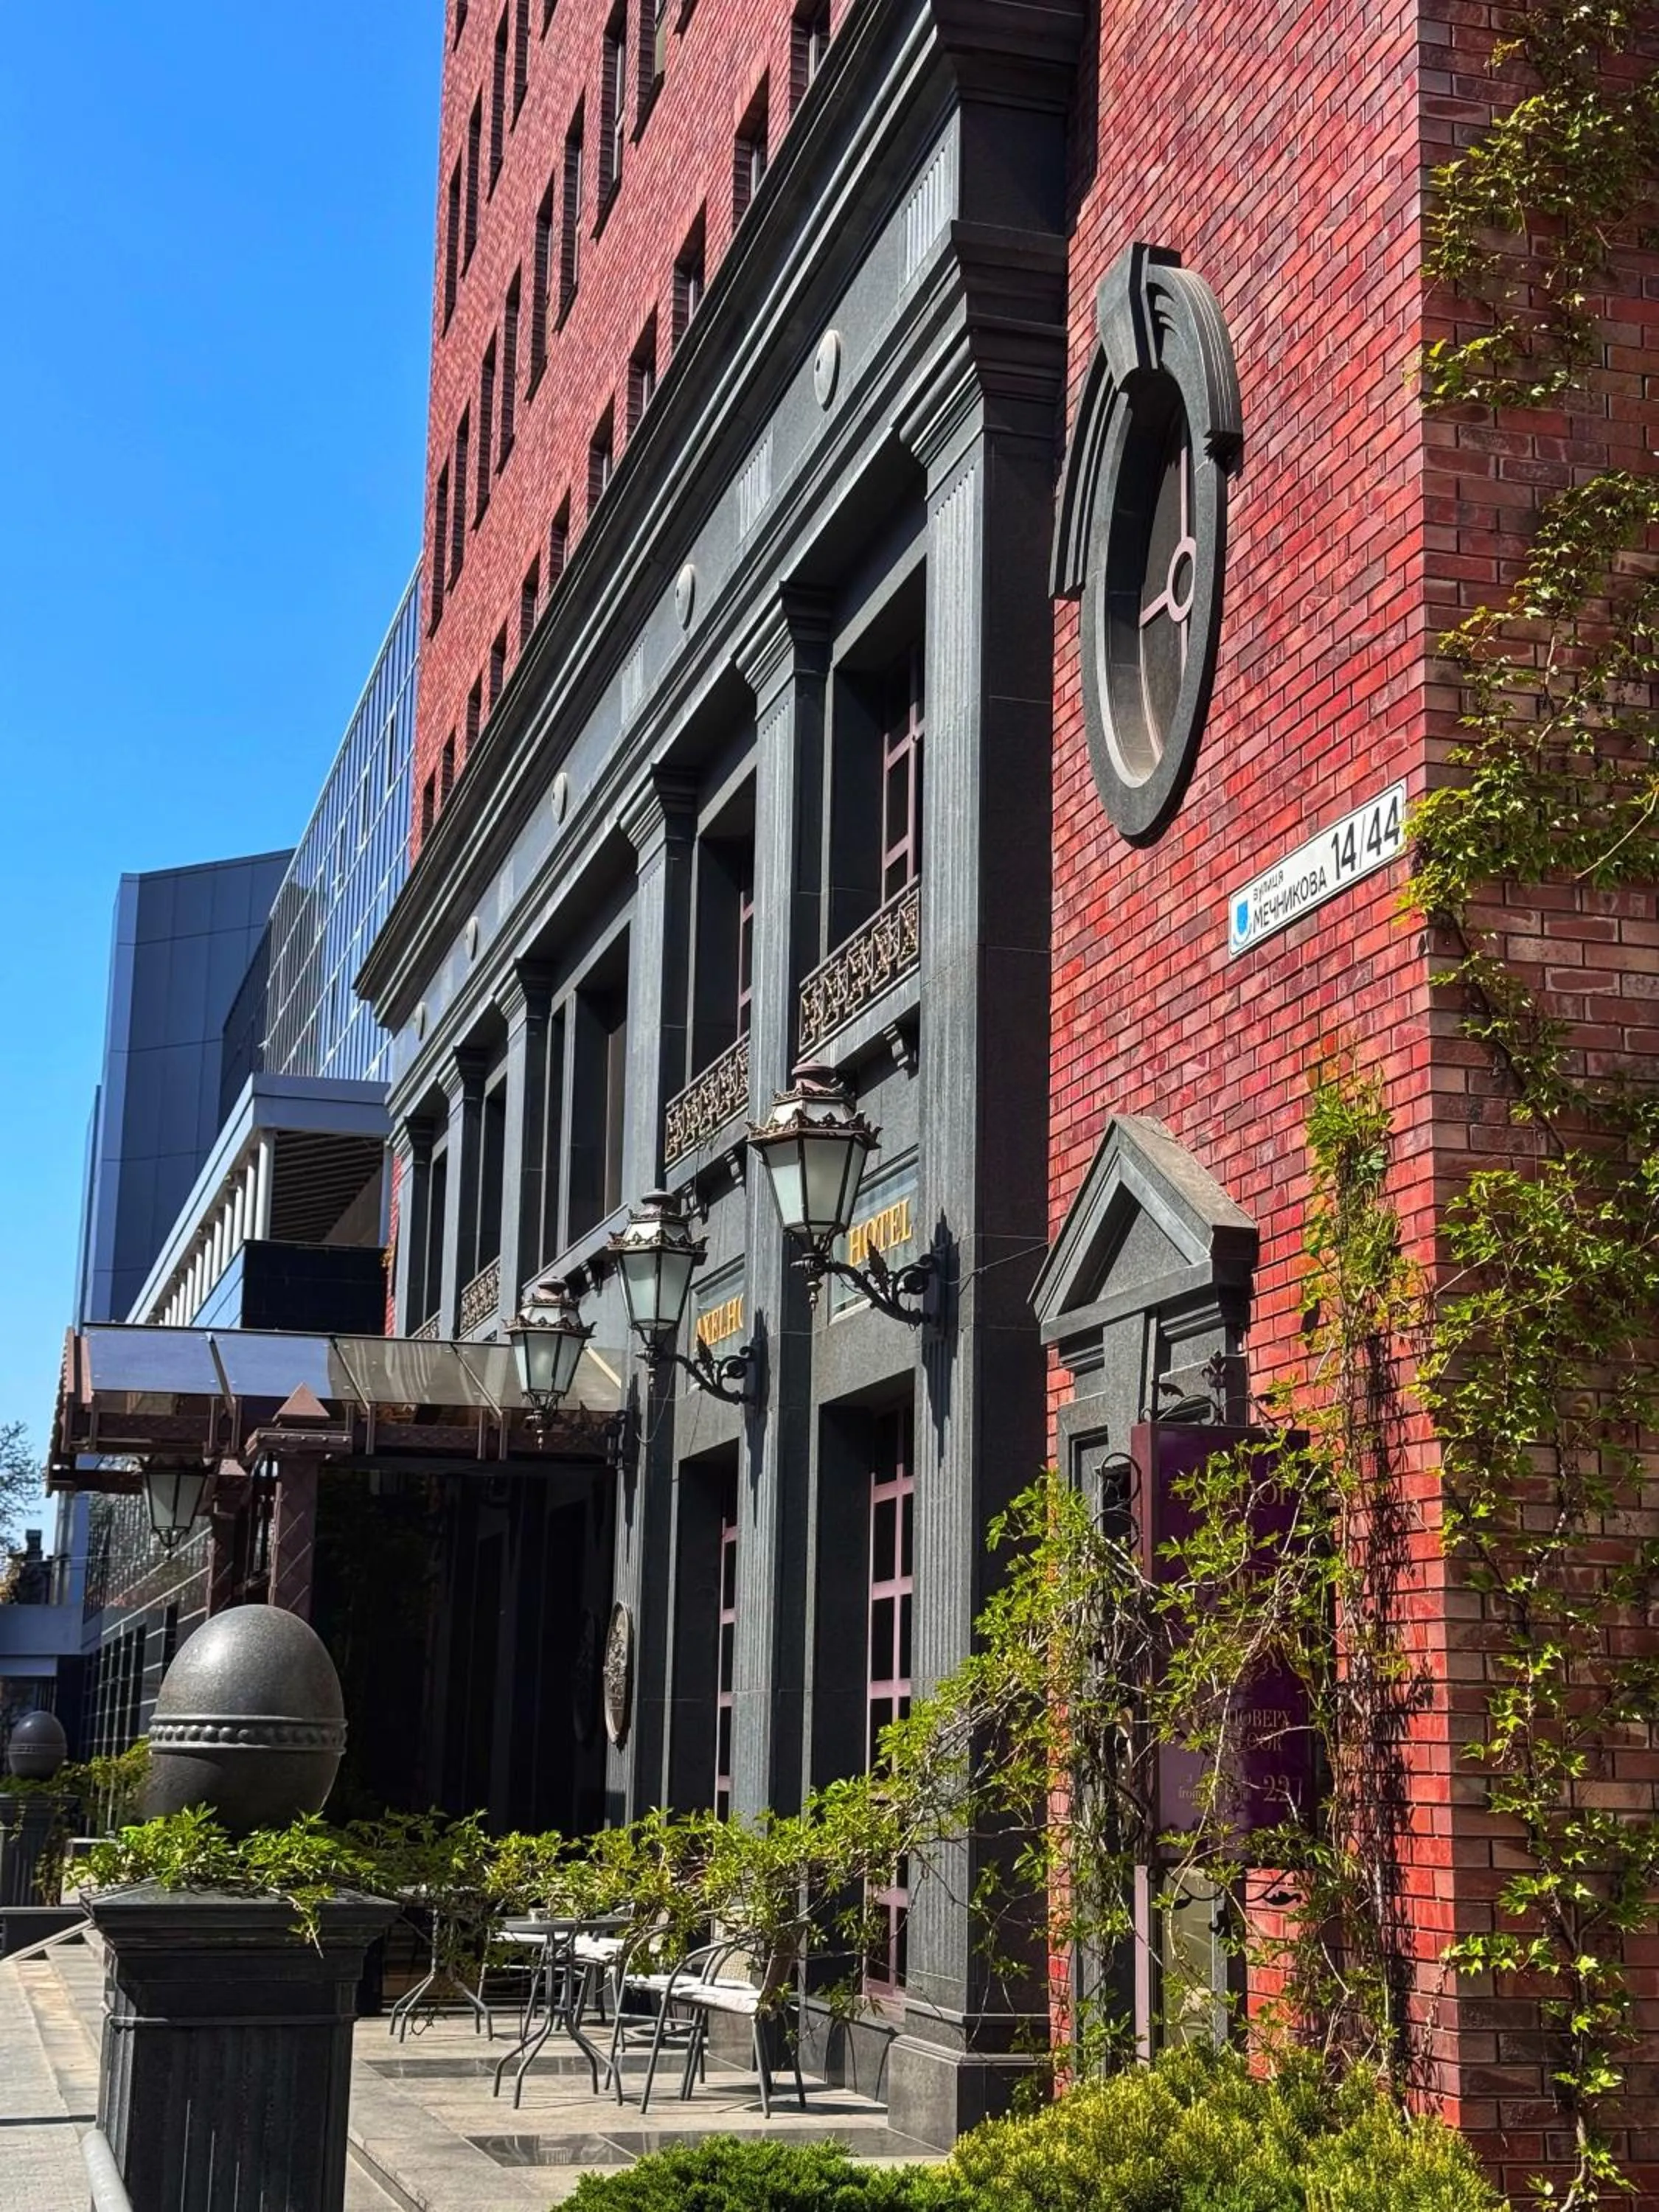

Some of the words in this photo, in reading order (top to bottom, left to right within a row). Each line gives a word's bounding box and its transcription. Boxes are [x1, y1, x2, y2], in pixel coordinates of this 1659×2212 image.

[1253, 866, 1327, 933] МЕЧНИКОВА
[1331, 796, 1399, 880] 14/44
[849, 1197, 913, 1267] HOTEL
